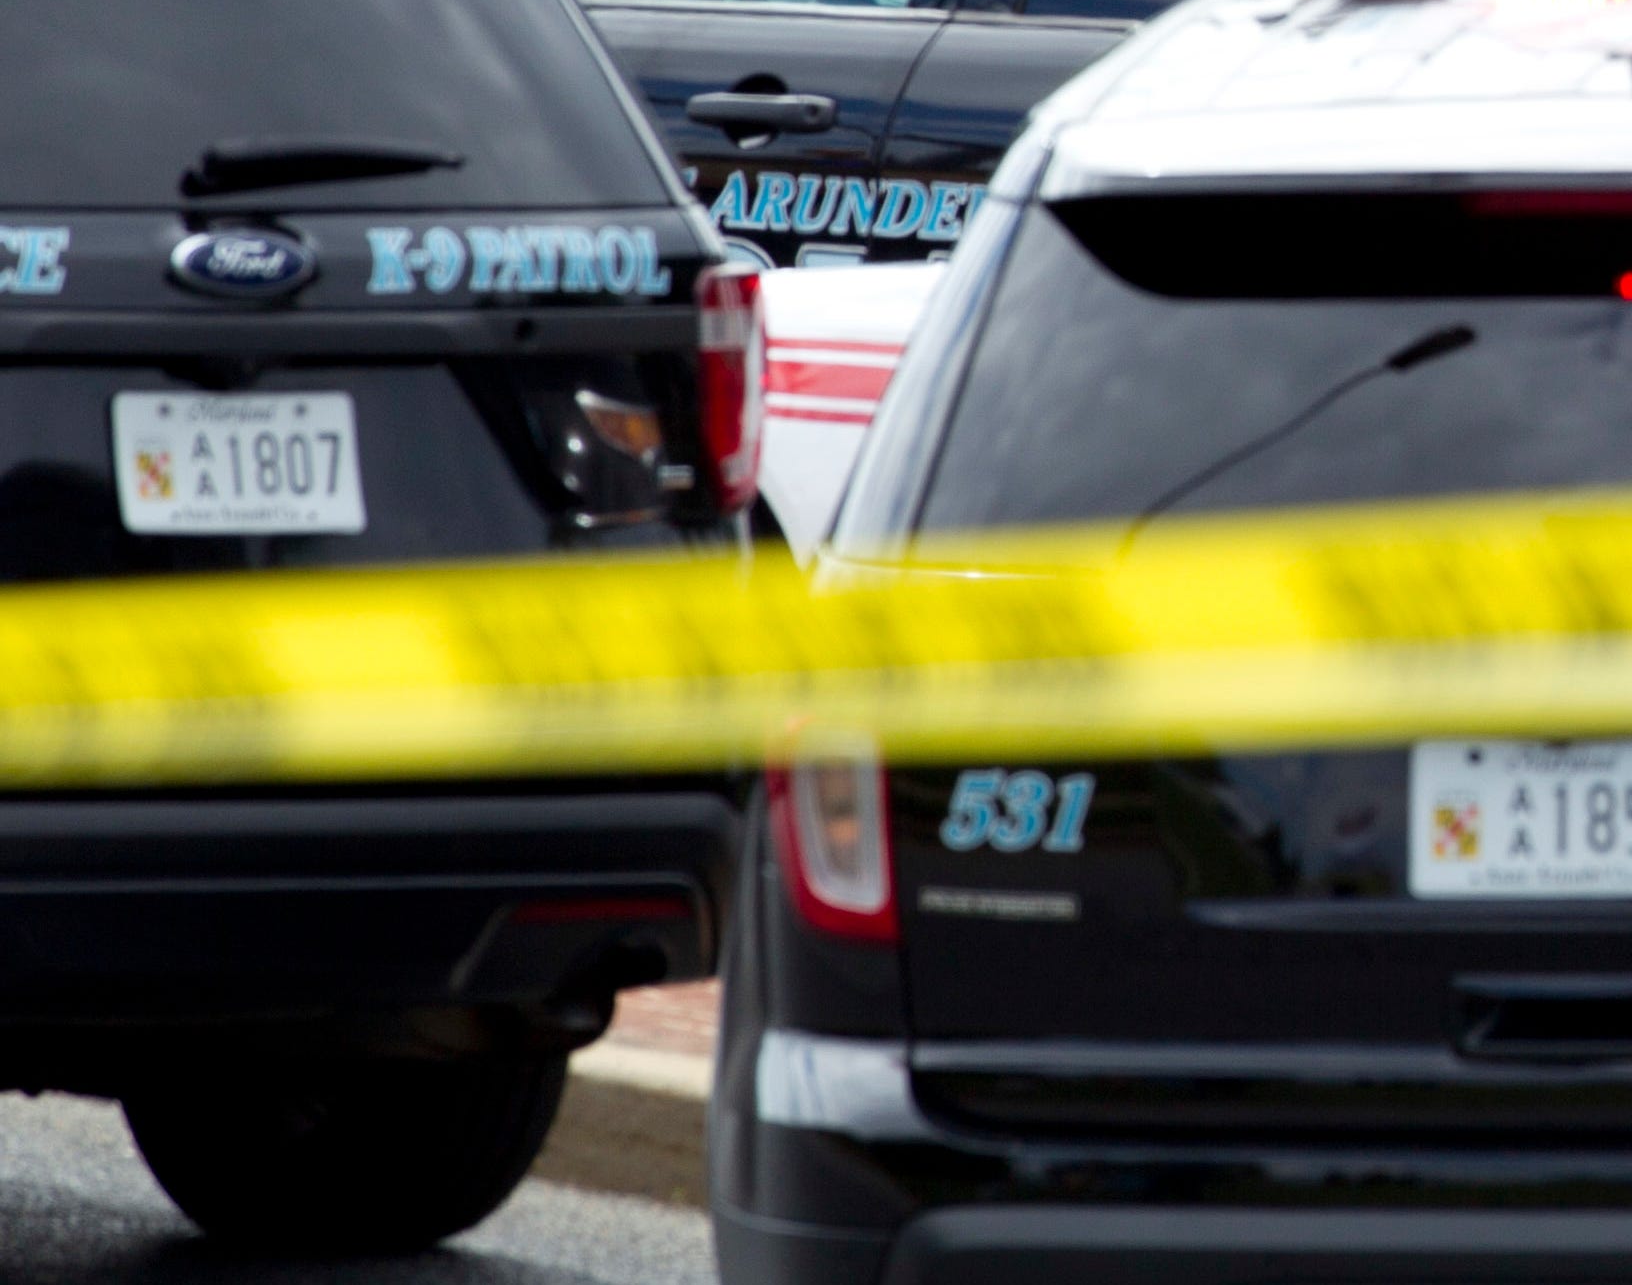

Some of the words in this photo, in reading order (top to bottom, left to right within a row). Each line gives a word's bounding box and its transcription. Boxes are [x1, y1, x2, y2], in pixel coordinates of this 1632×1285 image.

[207, 236, 287, 281] Ford
[366, 226, 466, 295] K-9
[468, 226, 671, 296] PATROL
[226, 430, 341, 498] 1807
[938, 768, 1096, 853] 531
